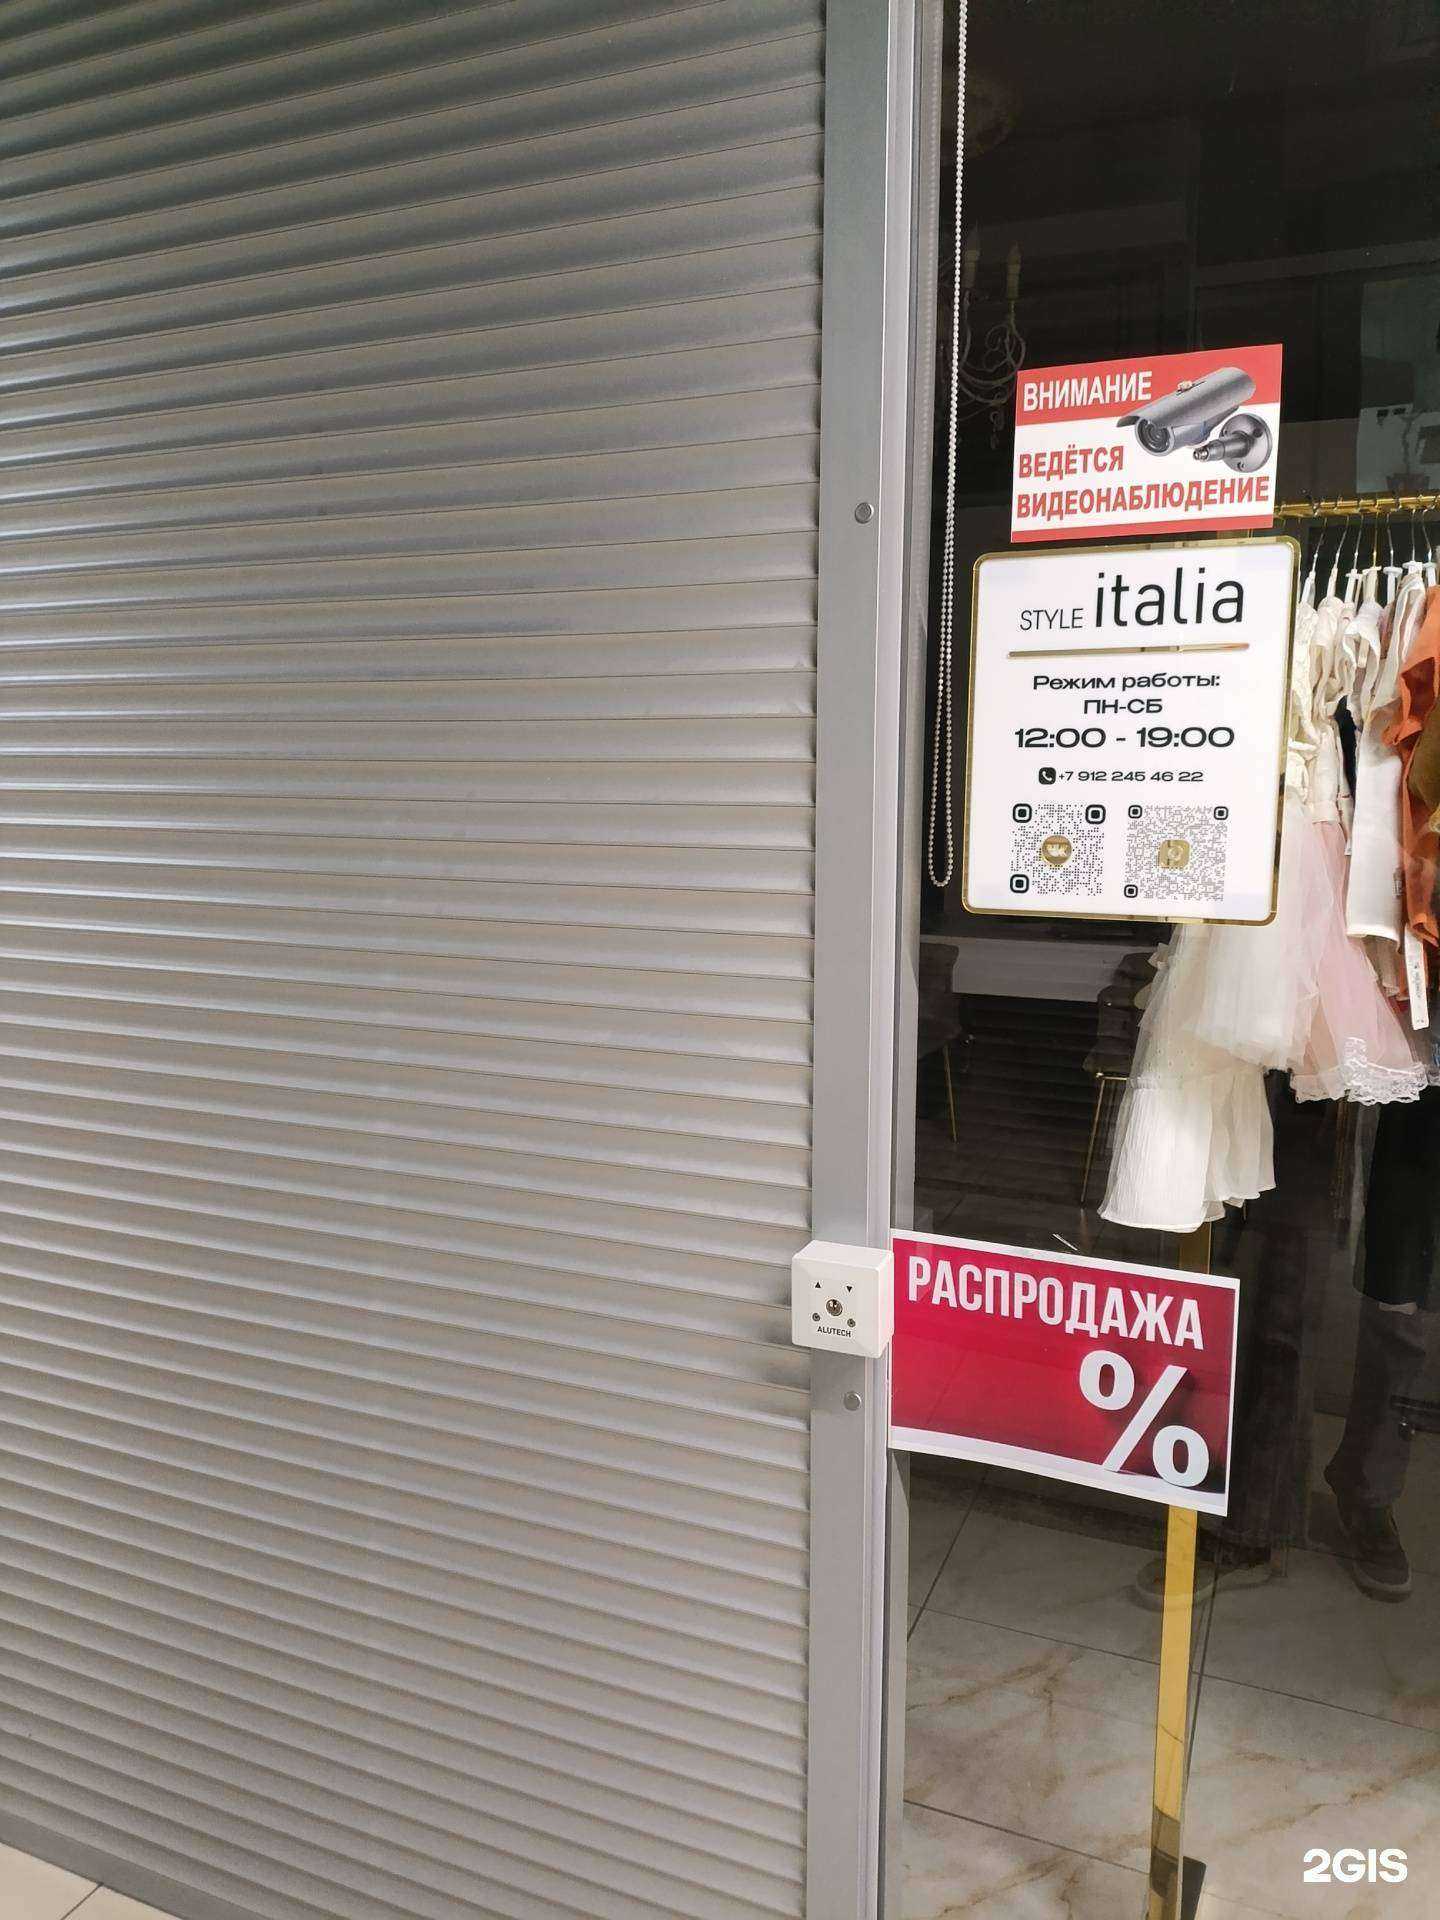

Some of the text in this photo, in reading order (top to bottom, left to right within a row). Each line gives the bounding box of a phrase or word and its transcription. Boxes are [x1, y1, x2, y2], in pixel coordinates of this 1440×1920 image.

[1023, 371, 1153, 412] ВНИМАНИЕ
[1018, 444, 1124, 481] ВЕДЁТСЯ
[1016, 476, 1270, 522] ВИДЕОНАБЛЮДЕНИЕ
[1019, 567, 1245, 631] STYLE italia
[1033, 673, 1221, 692] Режим работы:
[1083, 698, 1163, 714] ПН-СБ
[1014, 727, 1107, 749] 12:00
[1136, 726, 1235, 748] 19:00
[1058, 771, 1204, 782] +7 912 245 46 22
[908, 1255, 1204, 1351] РАСПРОДАЖА
[817, 1325, 852, 1338] ALUTECH
[1079, 1350, 1210, 1488] %
